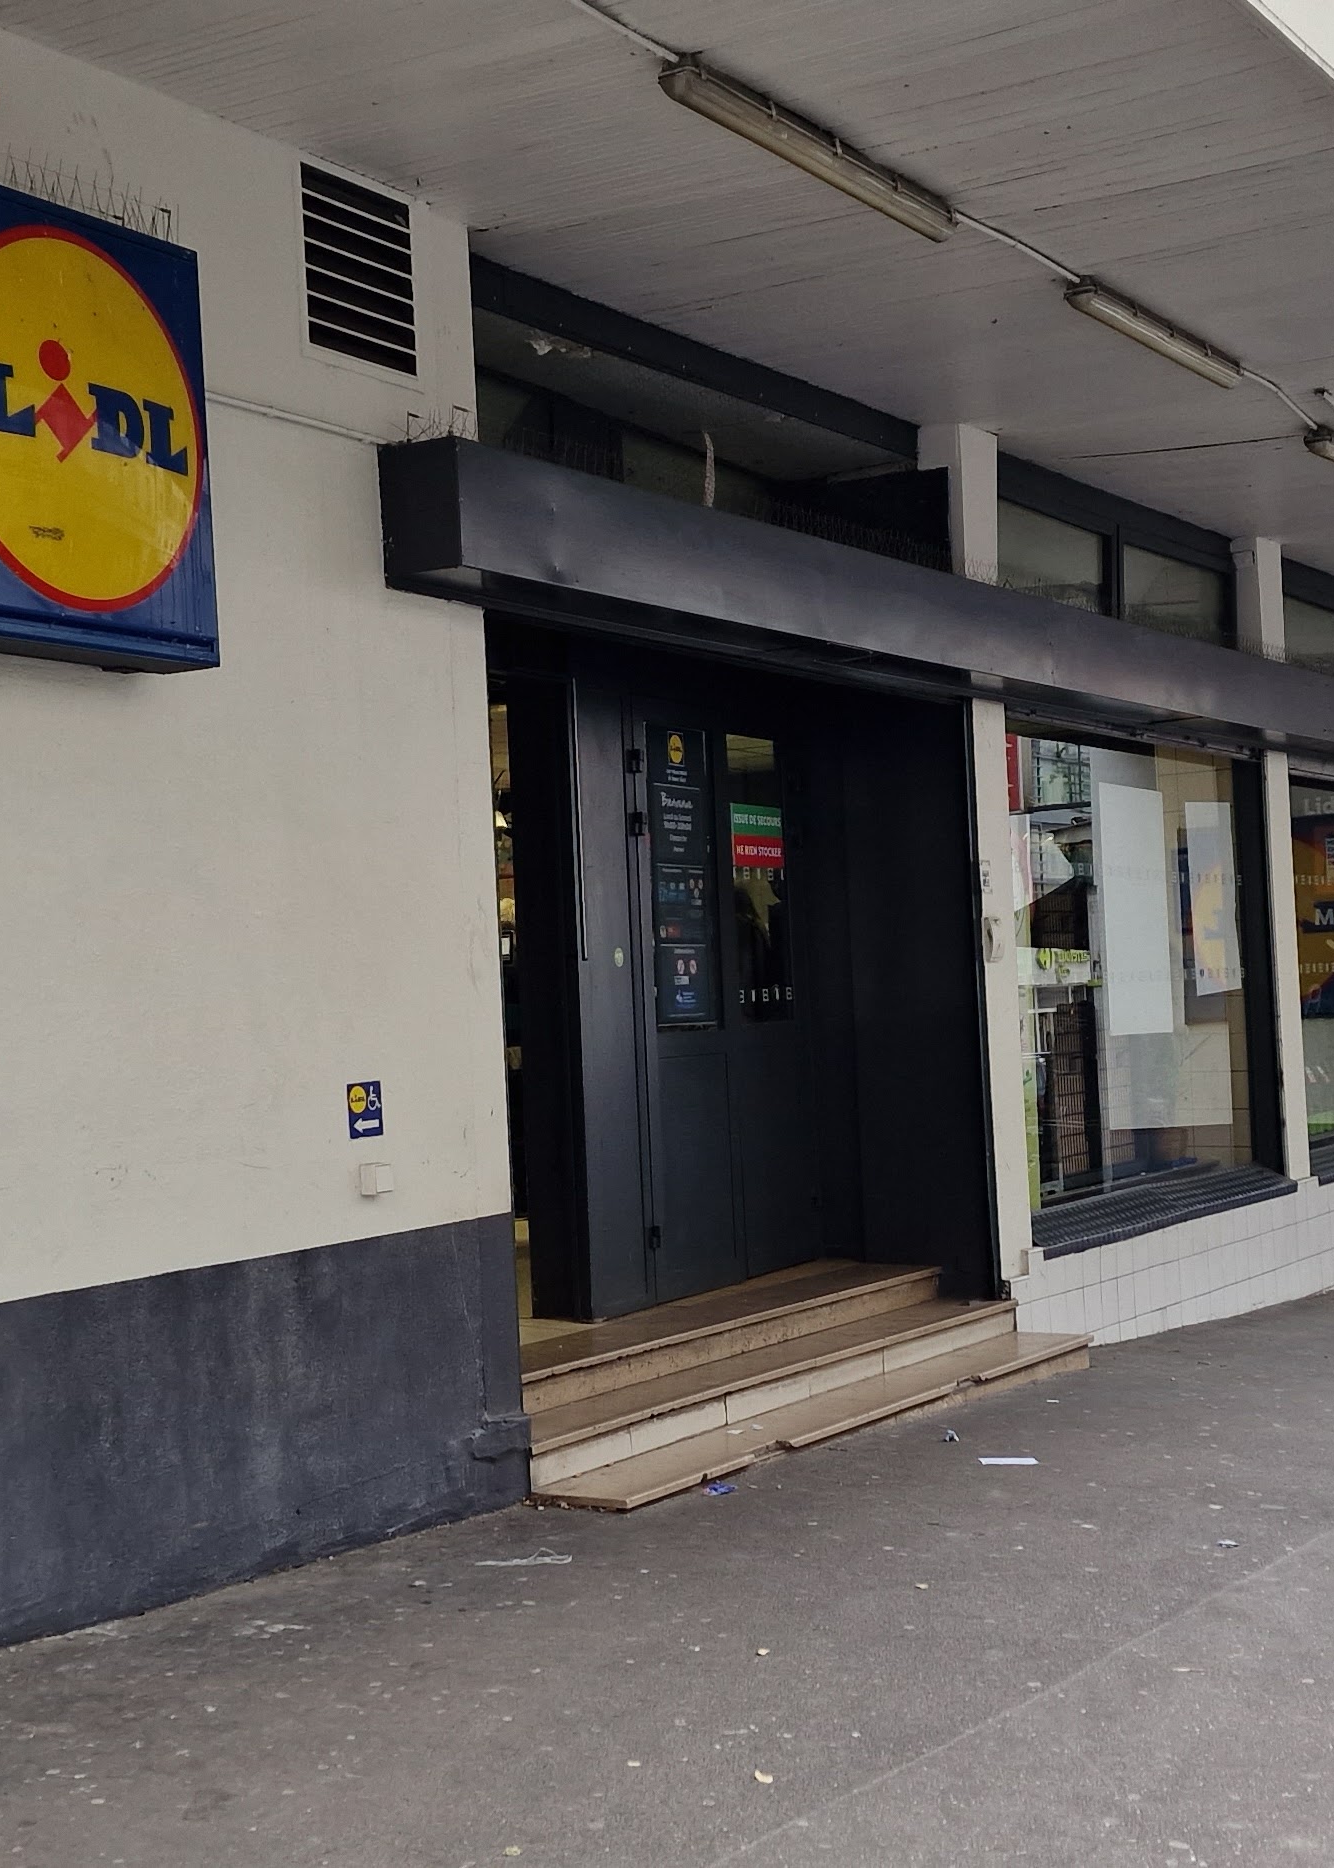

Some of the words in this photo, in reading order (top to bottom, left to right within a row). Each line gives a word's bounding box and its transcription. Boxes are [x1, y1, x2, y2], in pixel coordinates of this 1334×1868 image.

[733, 813, 748, 825] ISSUE
[749, 814, 757, 826] DE
[757, 815, 782, 828] SECOURS
[745, 844, 758, 857] RIEN
[758, 845, 782, 858] STOCKER
